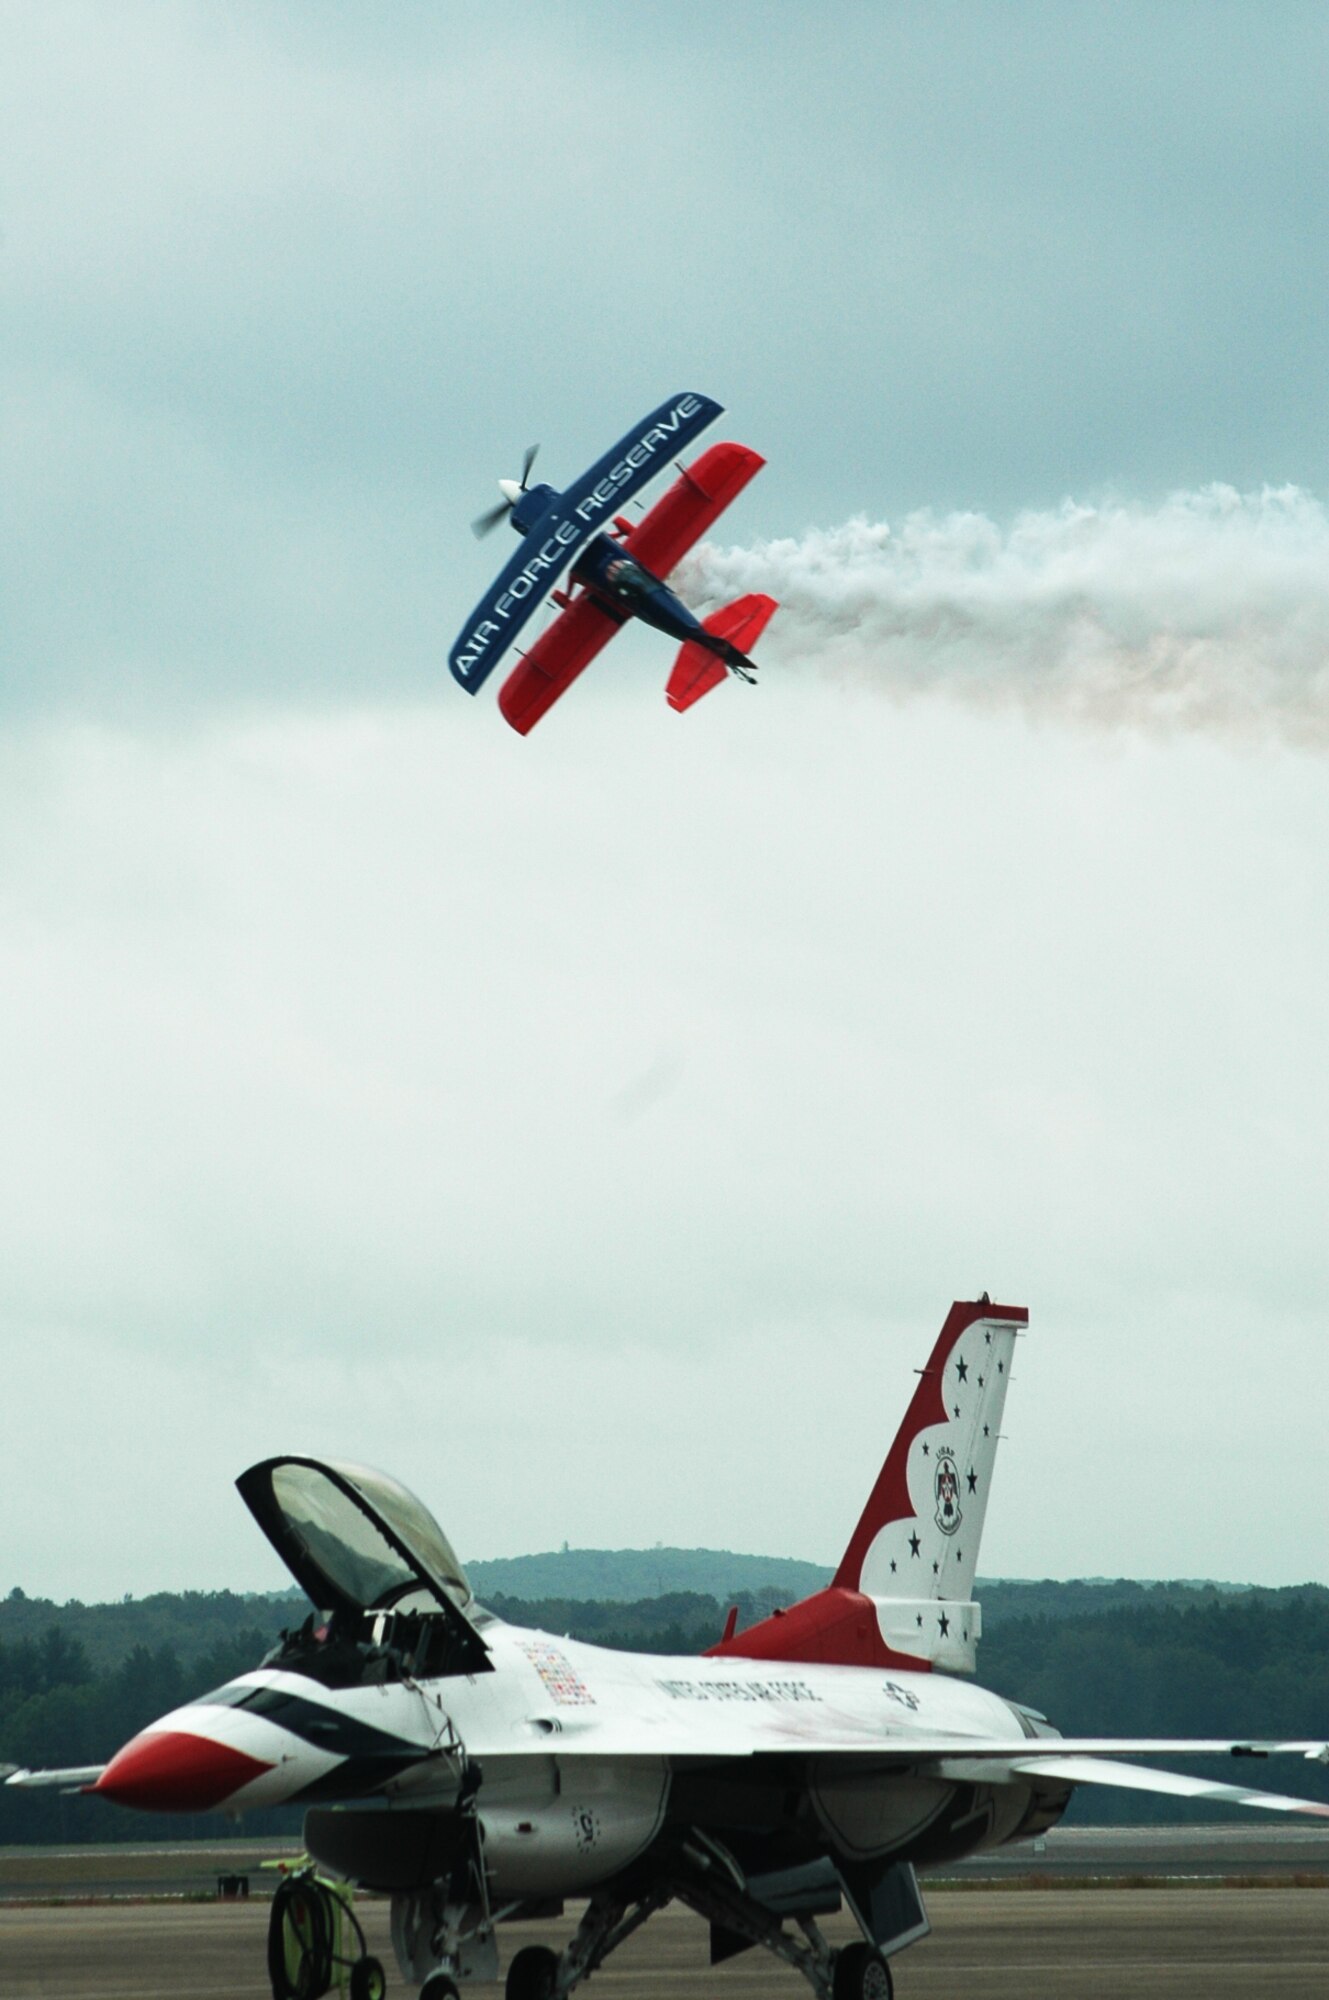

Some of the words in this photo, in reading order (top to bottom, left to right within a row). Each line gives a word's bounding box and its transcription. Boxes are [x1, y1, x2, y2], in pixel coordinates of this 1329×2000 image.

[455, 619, 501, 676] AIR
[494, 520, 582, 618] FORCE
[575, 394, 703, 521] RESERVE
